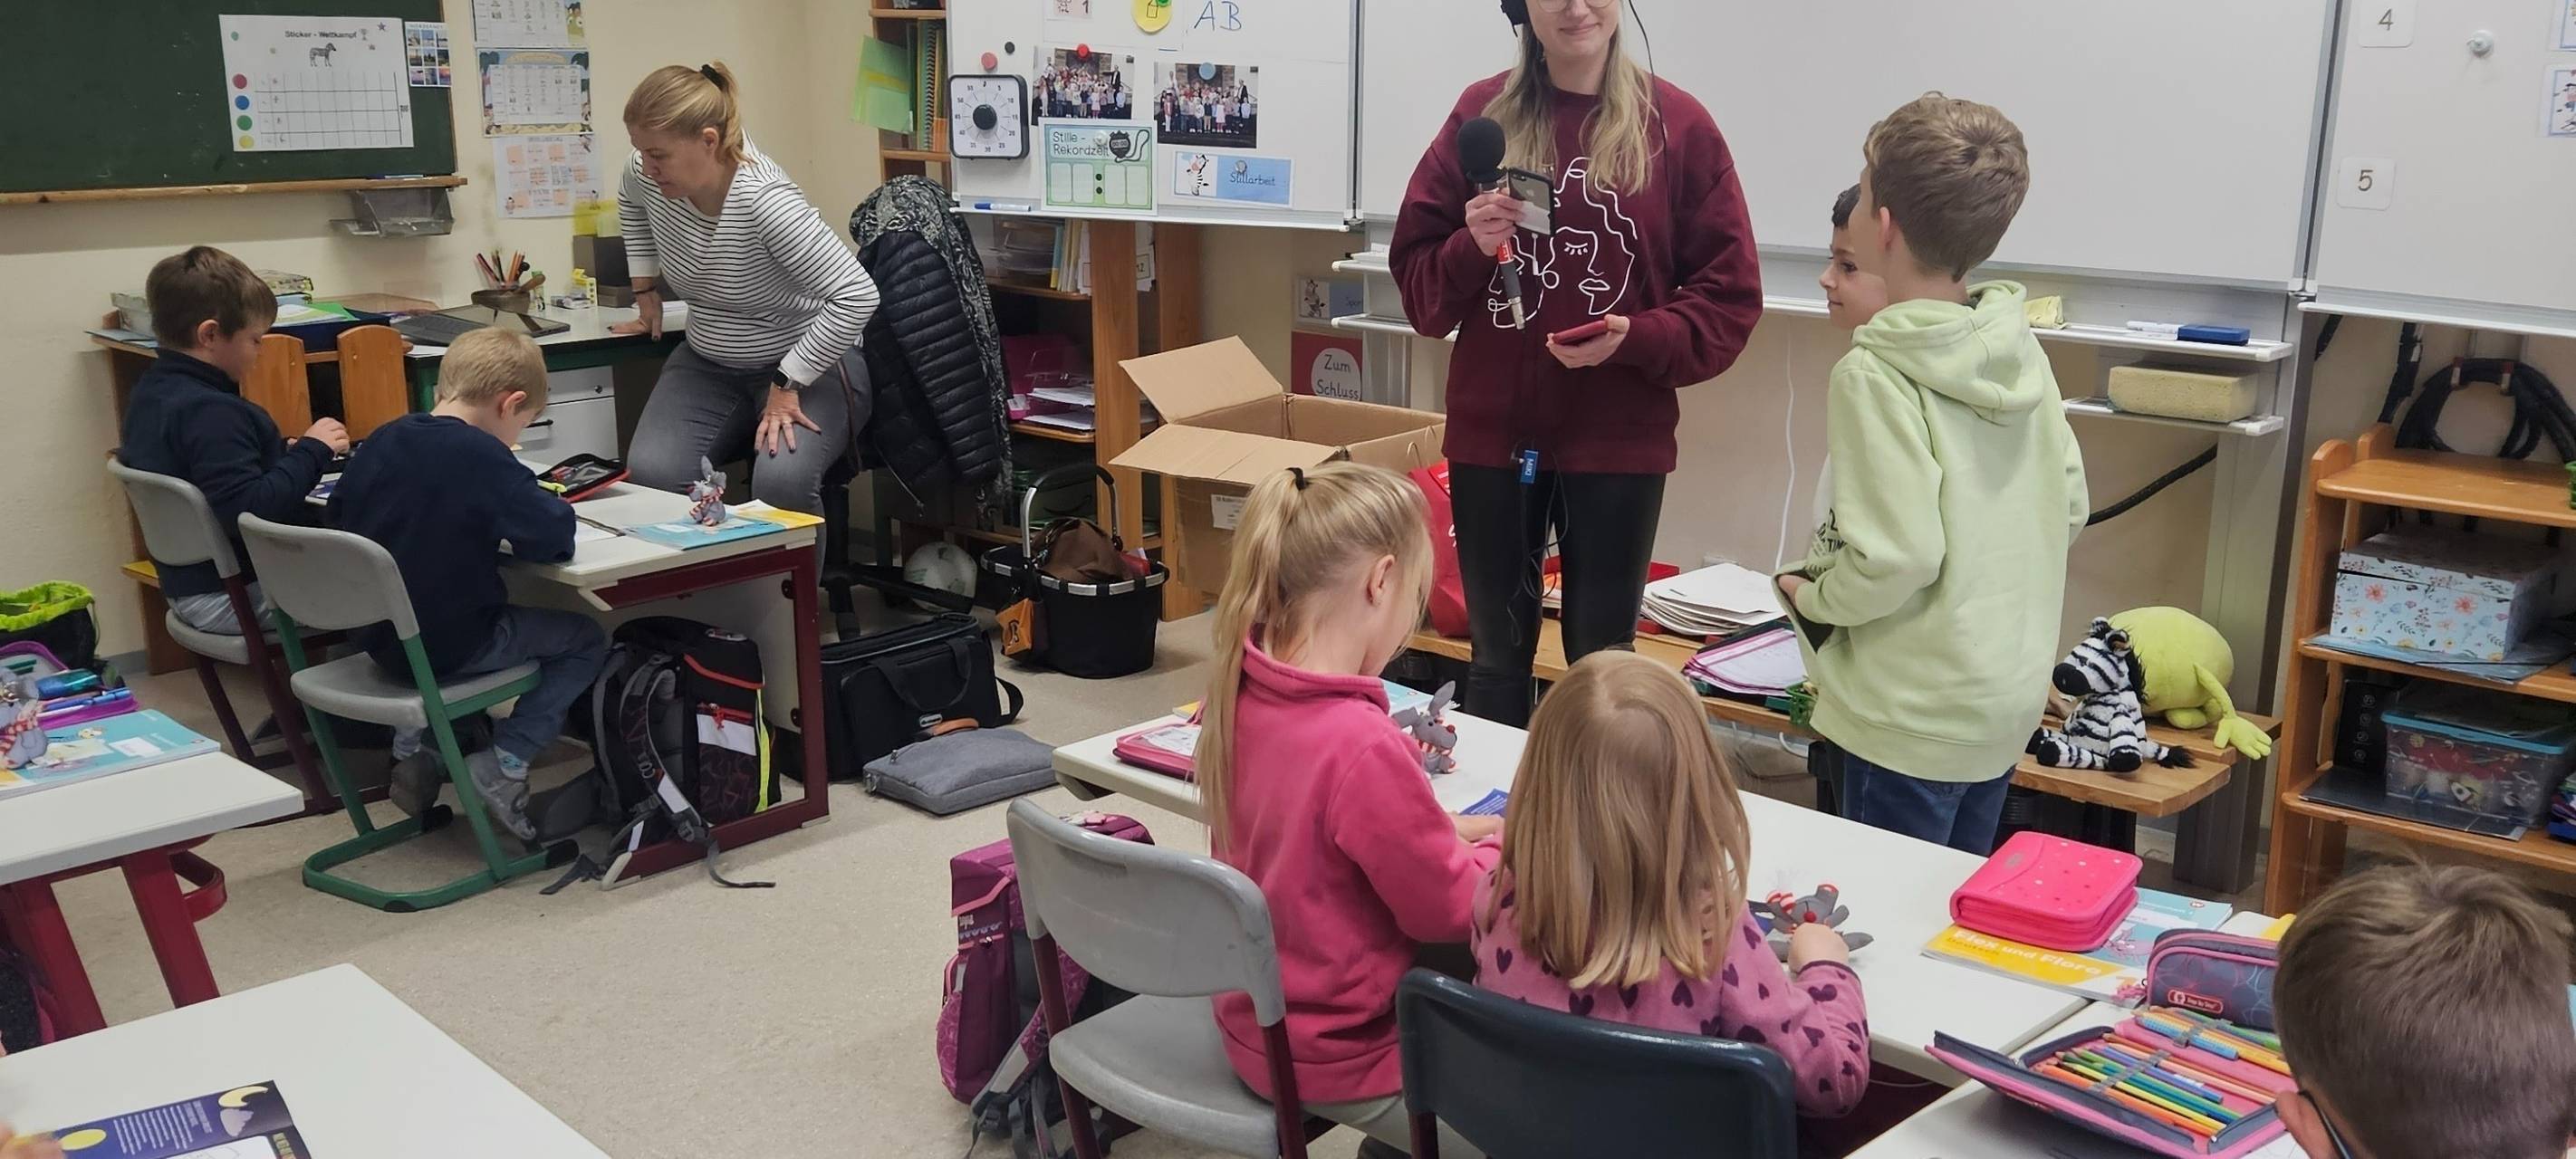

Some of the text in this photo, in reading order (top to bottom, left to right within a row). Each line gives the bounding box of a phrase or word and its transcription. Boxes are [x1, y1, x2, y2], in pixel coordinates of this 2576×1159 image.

[2378, 8, 2394, 31] 4
[284, 30, 312, 38] Sticker
[1053, 131, 1078, 143] Stille
[1053, 144, 1110, 158] Rekordzeit
[1230, 171, 1276, 187] Stillarbeit
[2357, 169, 2373, 191] 5
[1324, 353, 1351, 372] Zum
[1316, 378, 1360, 400] Schluss
[1953, 930, 1999, 949] Flex
[2002, 945, 2037, 960] und
[2040, 953, 2102, 975] Flora
